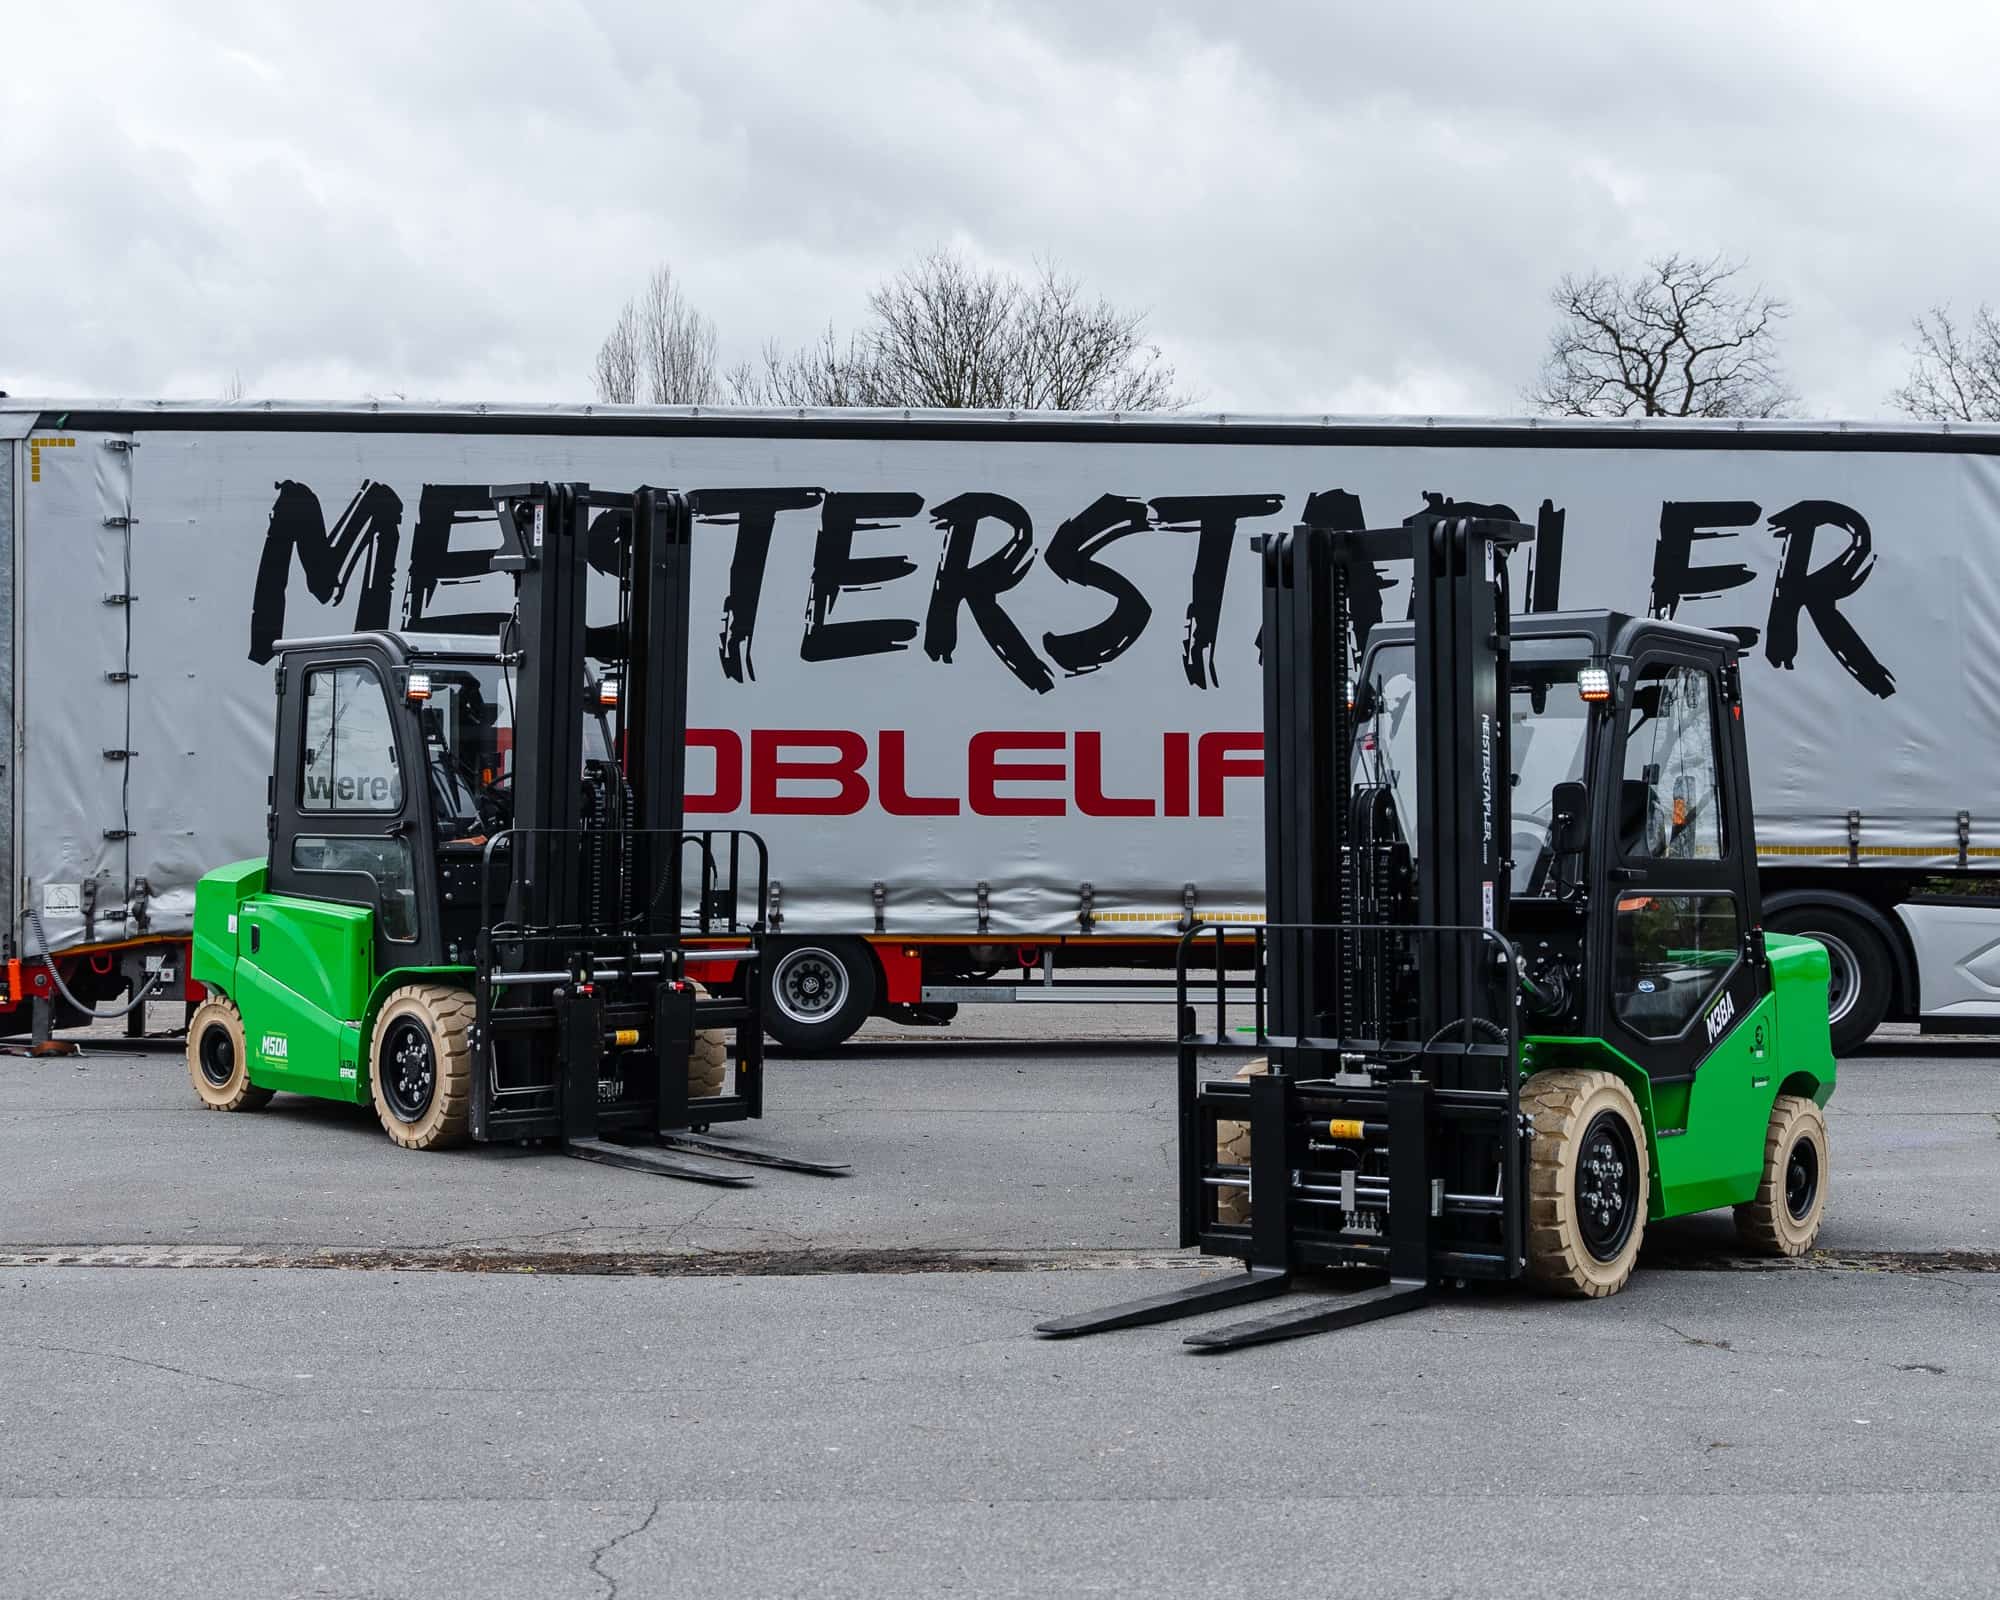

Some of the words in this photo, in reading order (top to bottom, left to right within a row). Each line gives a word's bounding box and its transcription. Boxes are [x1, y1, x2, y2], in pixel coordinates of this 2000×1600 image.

[248, 479, 1897, 700] METERSTER
[622, 727, 1265, 821] OBLELIF
[1482, 713, 1492, 842] MEISTERSTAPLER
[261, 1035, 288, 1057] M50A
[1706, 991, 1735, 1044] M38A
